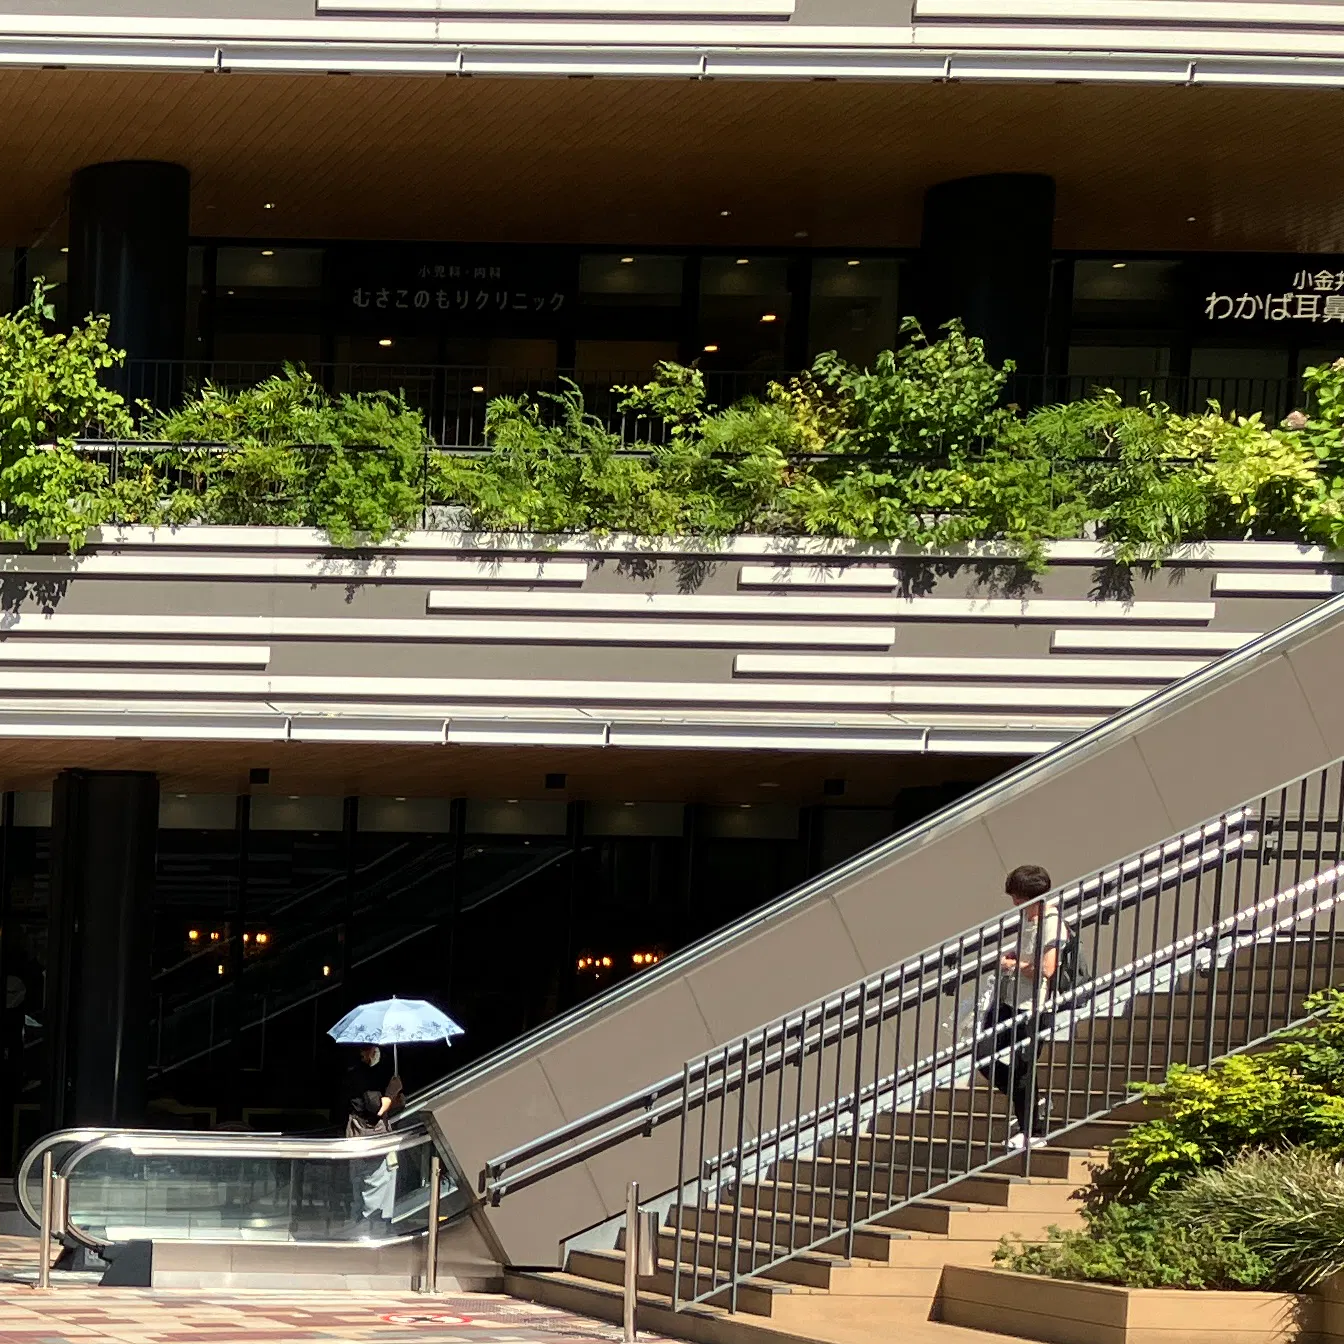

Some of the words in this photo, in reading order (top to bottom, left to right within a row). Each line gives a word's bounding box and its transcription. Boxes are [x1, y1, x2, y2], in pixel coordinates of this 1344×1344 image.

[417, 264, 502, 280] 小児科・内科
[352, 287, 566, 312] むさこのもりクリニック
[1204, 291, 1344, 323] わかば耳鼻
